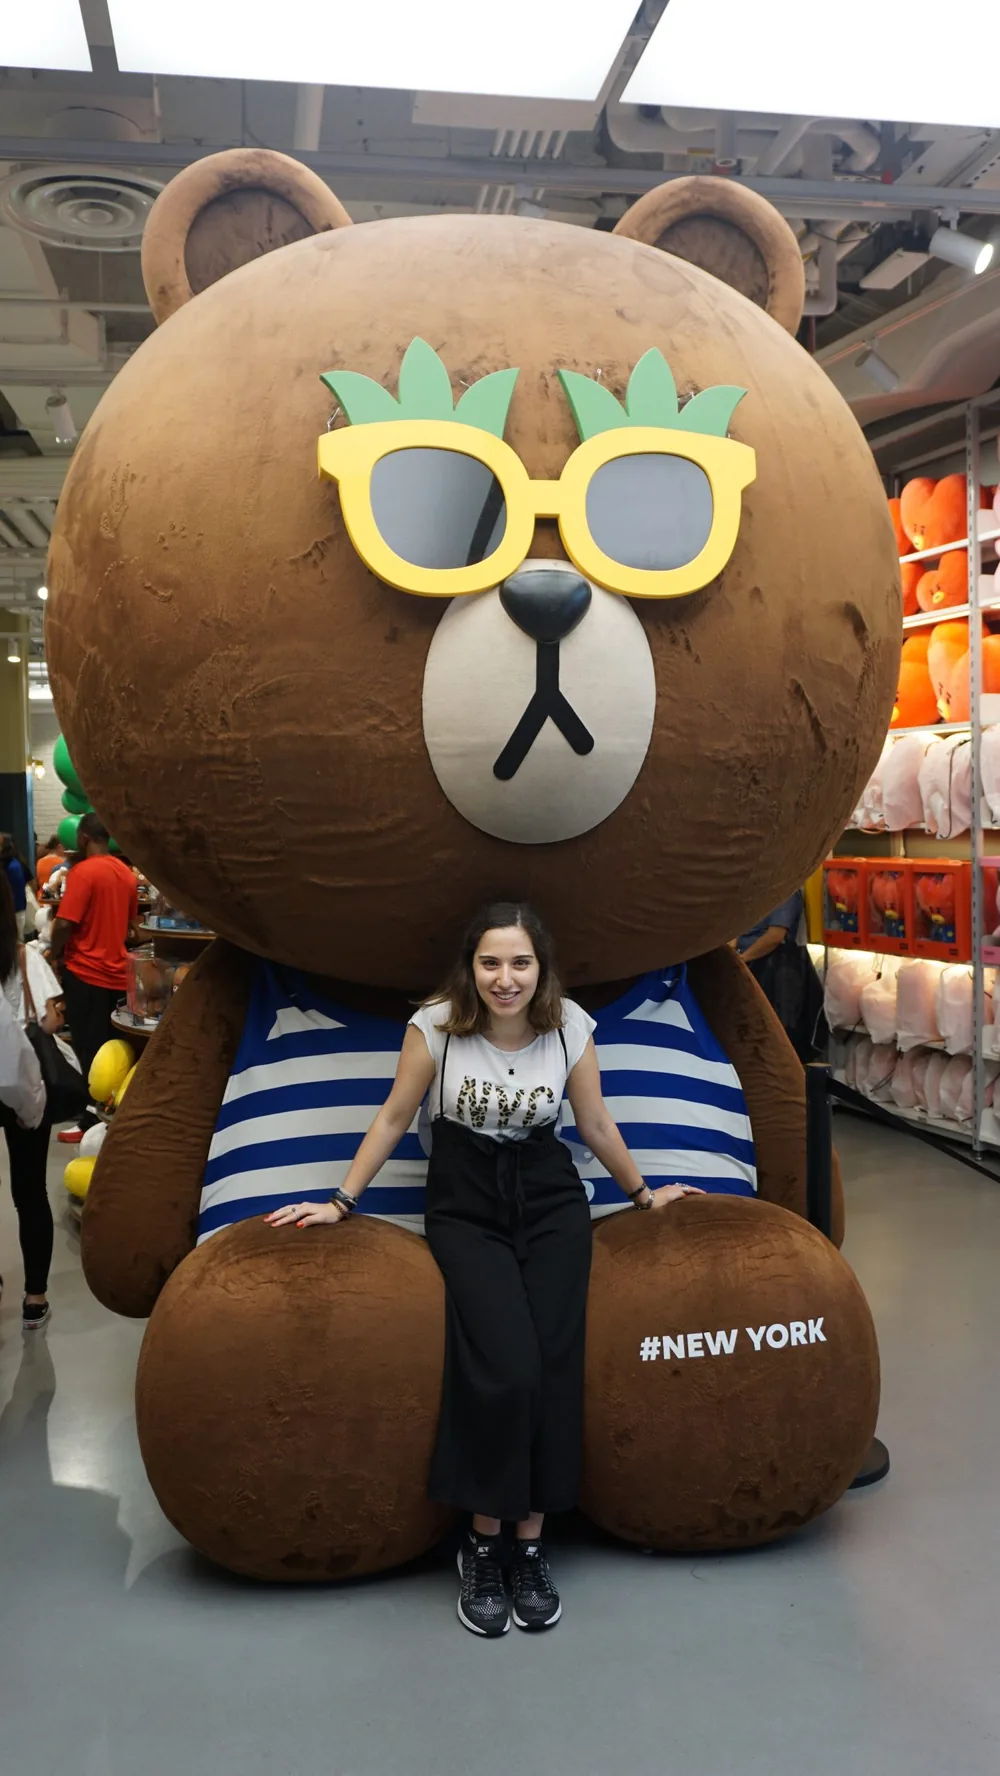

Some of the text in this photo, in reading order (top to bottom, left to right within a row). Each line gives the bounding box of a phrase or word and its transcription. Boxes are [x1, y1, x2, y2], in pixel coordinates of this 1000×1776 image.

[456, 1075, 554, 1128] NYC
[639, 1317, 827, 1361] #NEW YORK
